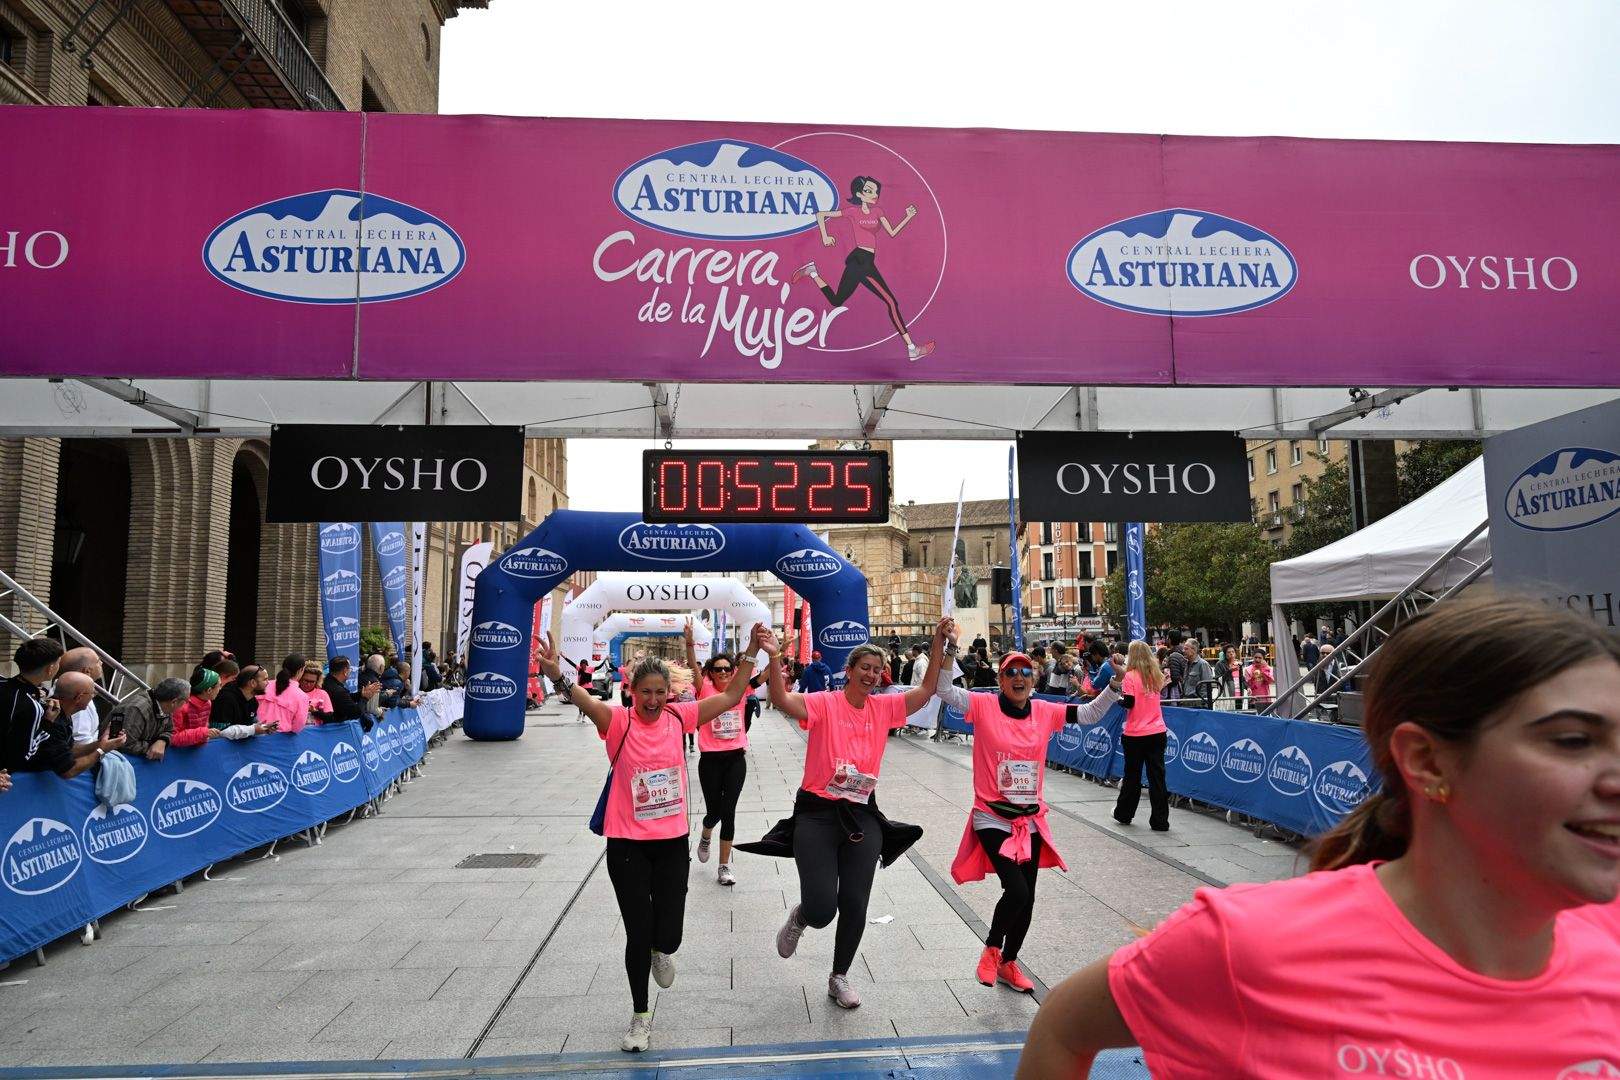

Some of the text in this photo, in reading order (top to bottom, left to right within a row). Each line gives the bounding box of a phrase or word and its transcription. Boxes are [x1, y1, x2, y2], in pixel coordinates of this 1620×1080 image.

[666, 172, 815, 186] CENTRAL LECHERA
[631, 174, 819, 216] ASTURIANA
[266, 229, 438, 241] CENTRAL LECHERA
[223, 231, 445, 274] ASTURIANA
[592, 230, 779, 286] Carrera
[1120, 245, 1272, 257] CENTRAL LECHERA
[1086, 247, 1281, 289] ASTURIANA
[1409, 254, 1578, 291] OYSHO
[638, 283, 848, 370] de la Mujer
[310, 456, 488, 493] OYSHO
[1055, 461, 1217, 495] OYSHO
[1530, 477, 1570, 492] CENTRAL
[626, 530, 718, 551] ASTURIANA
[503, 557, 562, 572] ASTURIANA
[781, 557, 838, 572] ASTURIANA
[627, 584, 710, 601] OYSHO
[474, 632, 518, 644] ASTURIANA
[823, 632, 867, 643] ASTURIANA
[469, 681, 513, 694] ASTURIANA
[1182, 744, 1216, 766] ASTURIANA
[1223, 753, 1263, 776] ASTURIANA
[651, 787, 668, 797] 016
[1013, 777, 1030, 785] 016
[231, 780, 285, 806] ASTURIANA
[157, 798, 218, 830] ASTURIANA
[88, 822, 145, 854] ASTURIANA
[10, 843, 80, 885] ASTURIANA
[1337, 1044, 1465, 1080] OYSHO
